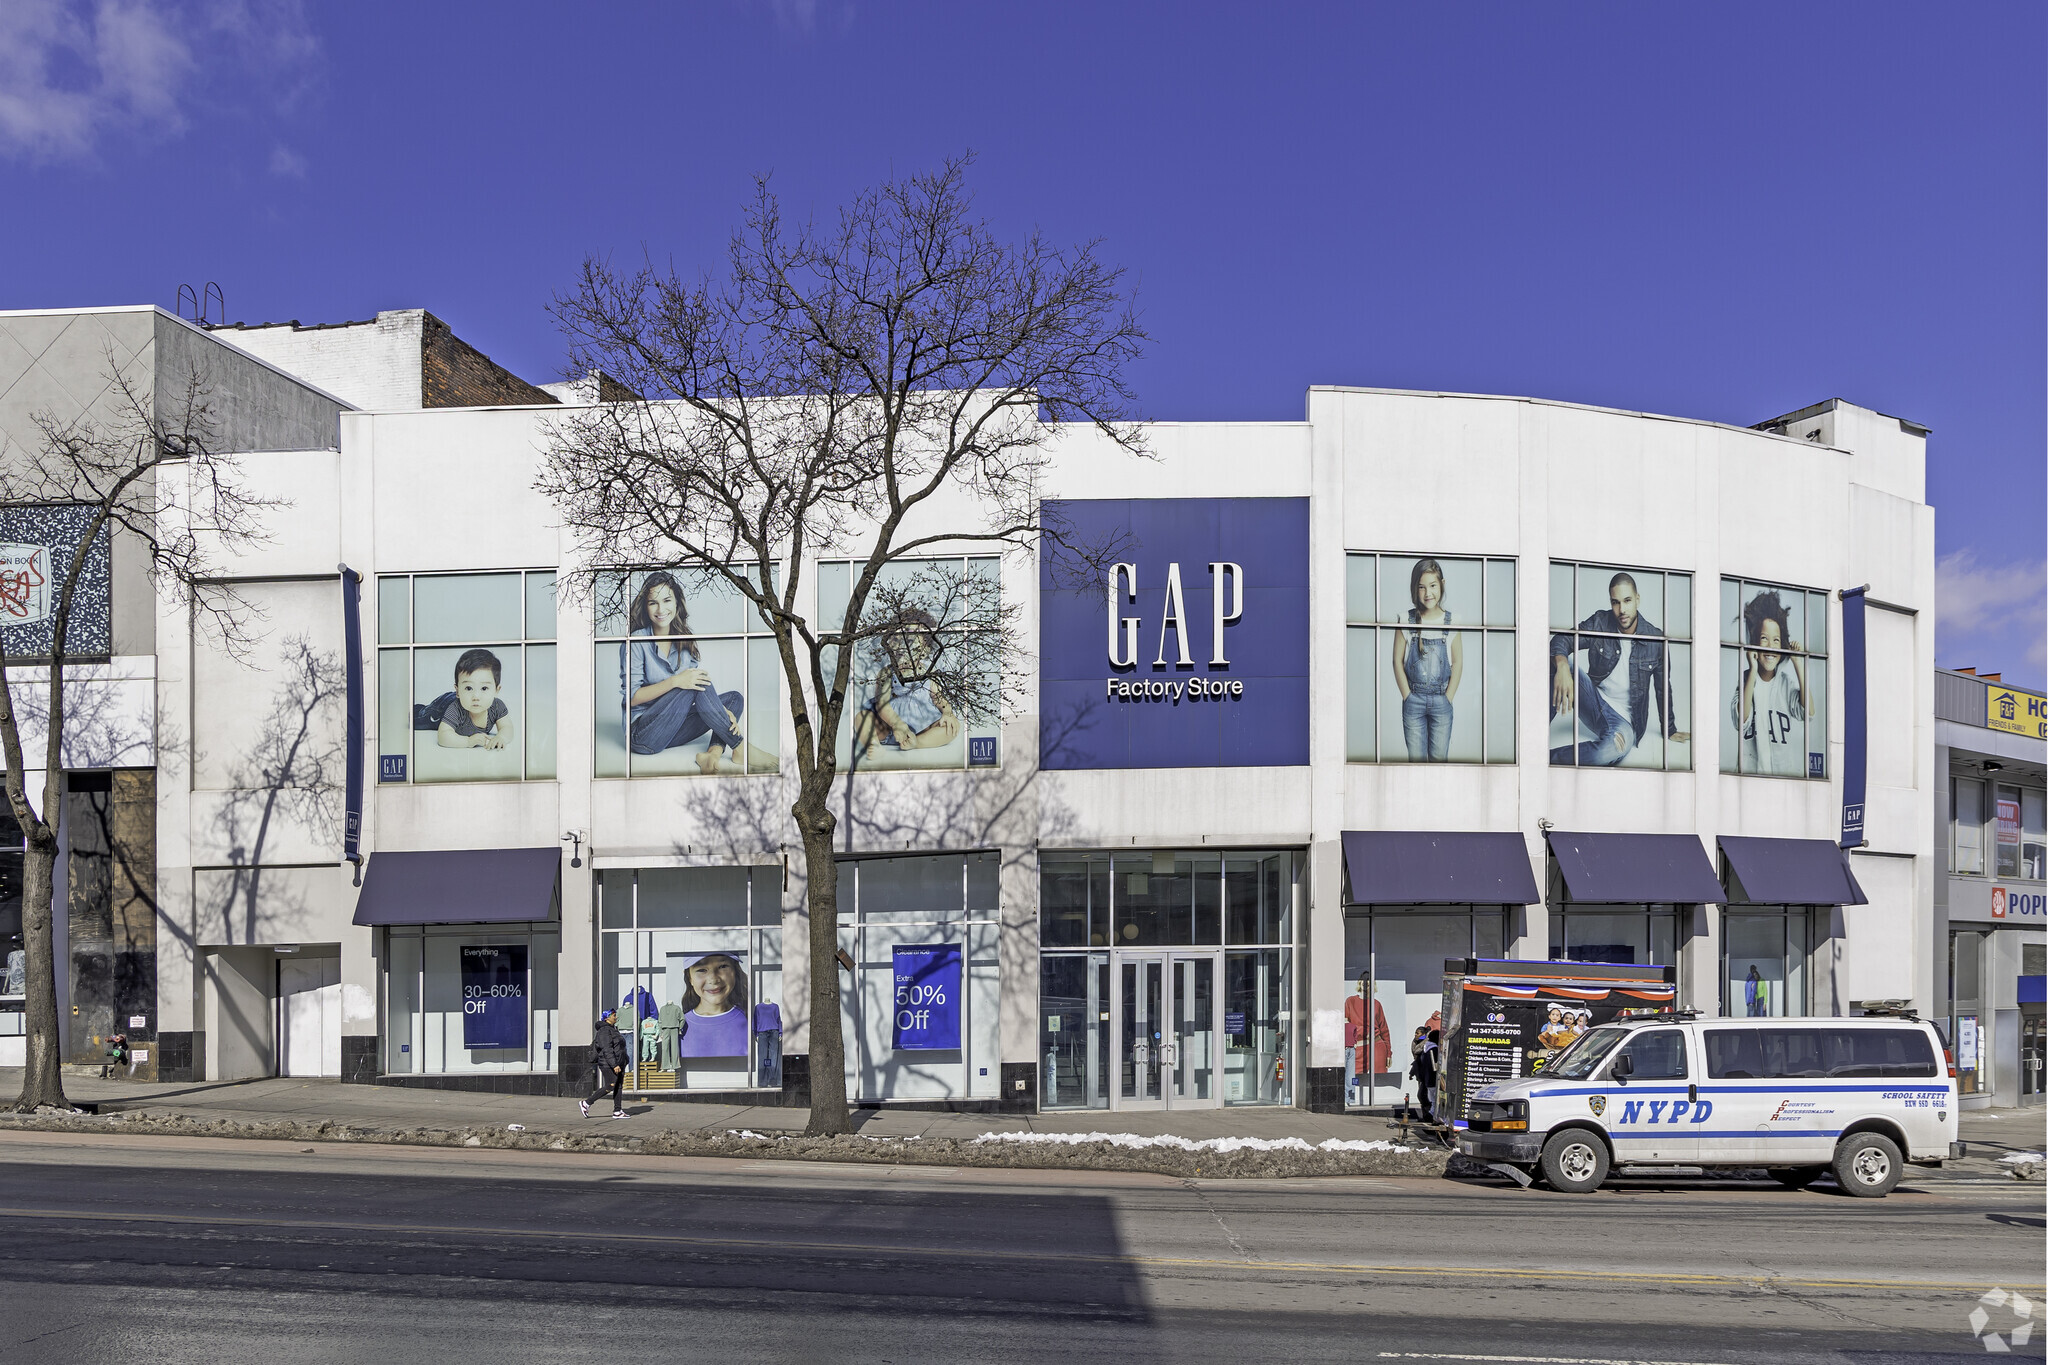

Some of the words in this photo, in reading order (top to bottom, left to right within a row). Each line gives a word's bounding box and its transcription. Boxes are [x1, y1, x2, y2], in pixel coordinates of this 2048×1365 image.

[1107, 562, 1244, 667] GAP
[1107, 678, 1185, 700] Factory
[1187, 677, 1244, 696] Store
[973, 741, 993, 757] GAP
[383, 758, 404, 774] GAP
[1809, 756, 1823, 770] GAP
[1847, 809, 1861, 821] GAP
[464, 948, 499, 956] Everything
[896, 948, 931, 956] Clearance
[896, 974, 914, 982] Extra
[896, 984, 946, 1006] 50%
[464, 1000, 487, 1014] Off
[896, 1009, 930, 1031] Off
[1468, 1037, 1511, 1045] EMPANADAS
[1619, 1100, 1713, 1124] NYPD
